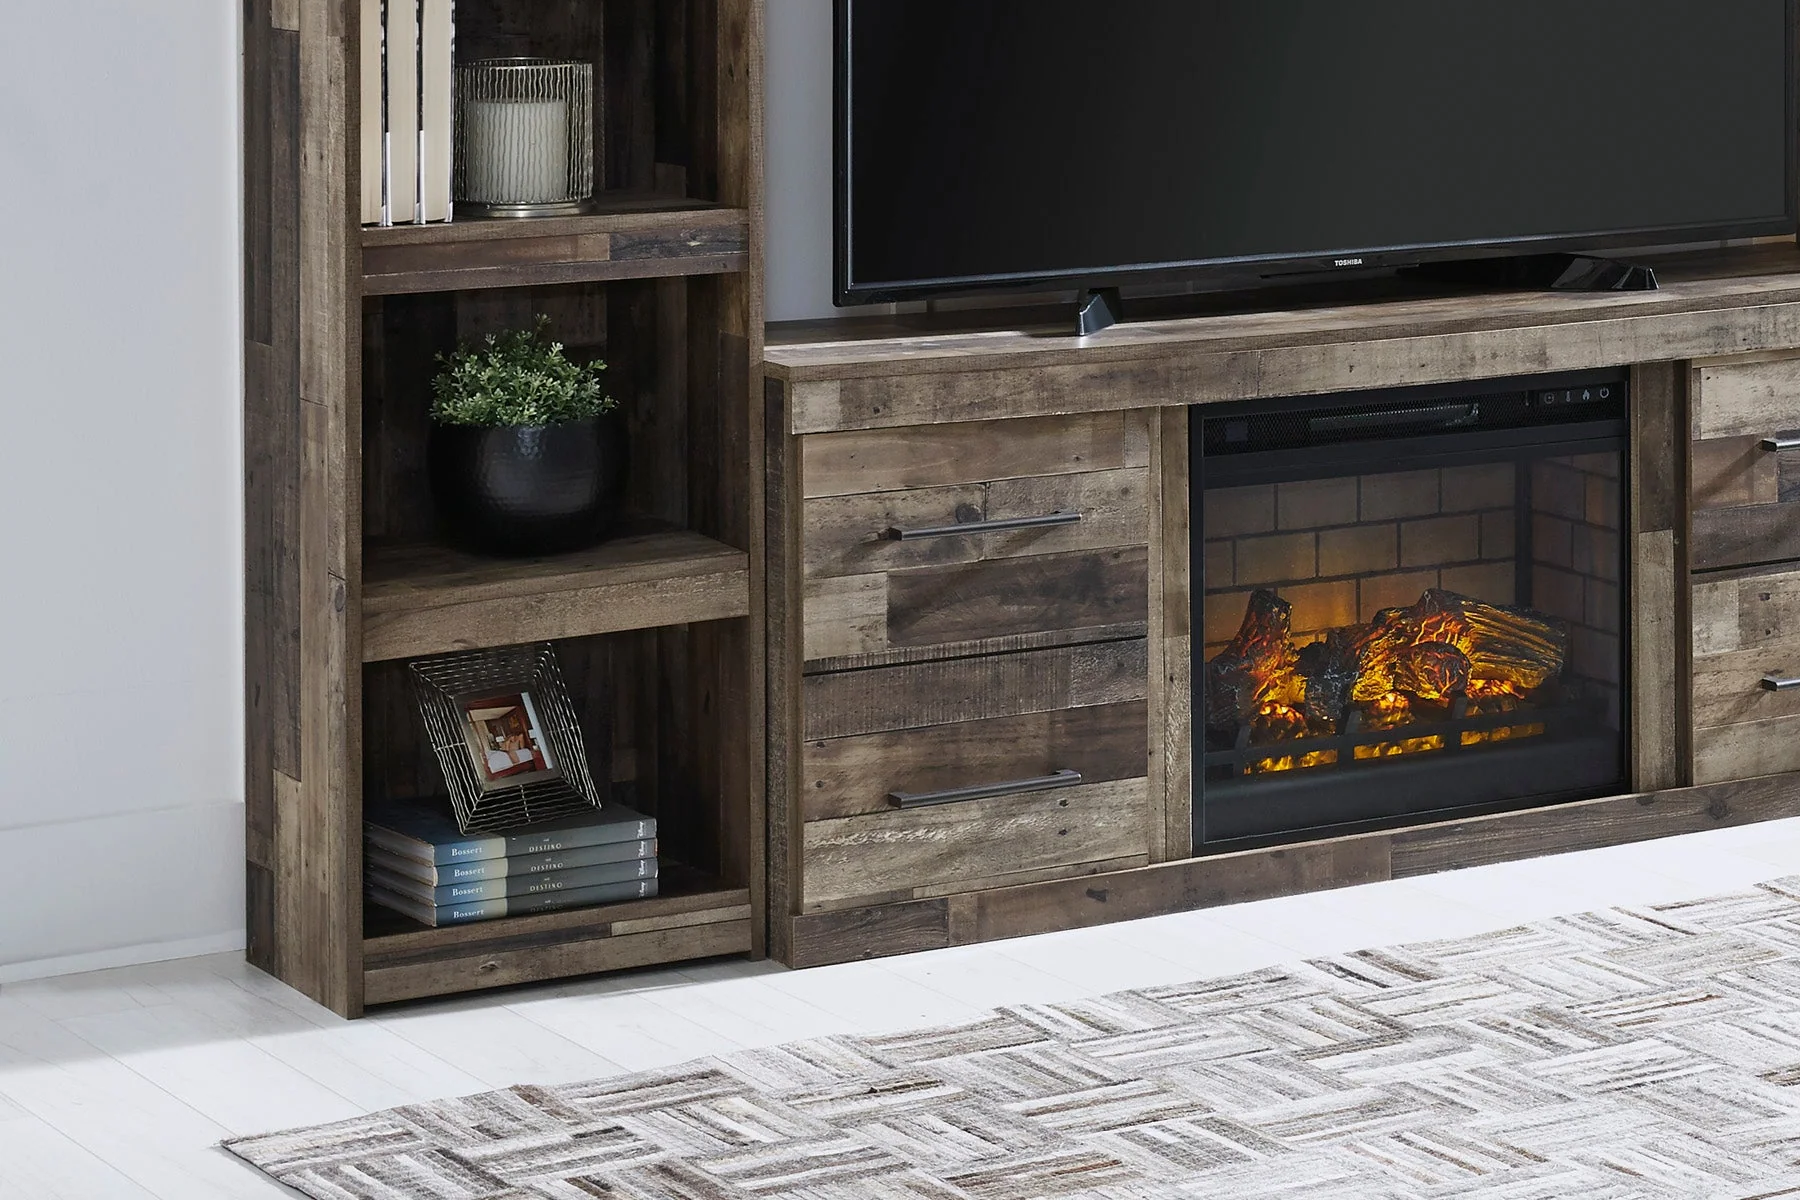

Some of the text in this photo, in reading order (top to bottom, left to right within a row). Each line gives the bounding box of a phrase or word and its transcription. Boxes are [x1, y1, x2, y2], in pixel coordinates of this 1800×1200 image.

[1334, 258, 1363, 267] TOSHIBA
[451, 846, 483, 857] Bossert
[529, 843, 562, 853] DESTINO
[454, 867, 485, 877] Bossert
[530, 862, 564, 872] DESTINO
[452, 886, 483, 897] Bossert
[530, 882, 563, 892] DESTINO
[453, 909, 485, 919] Bossert
